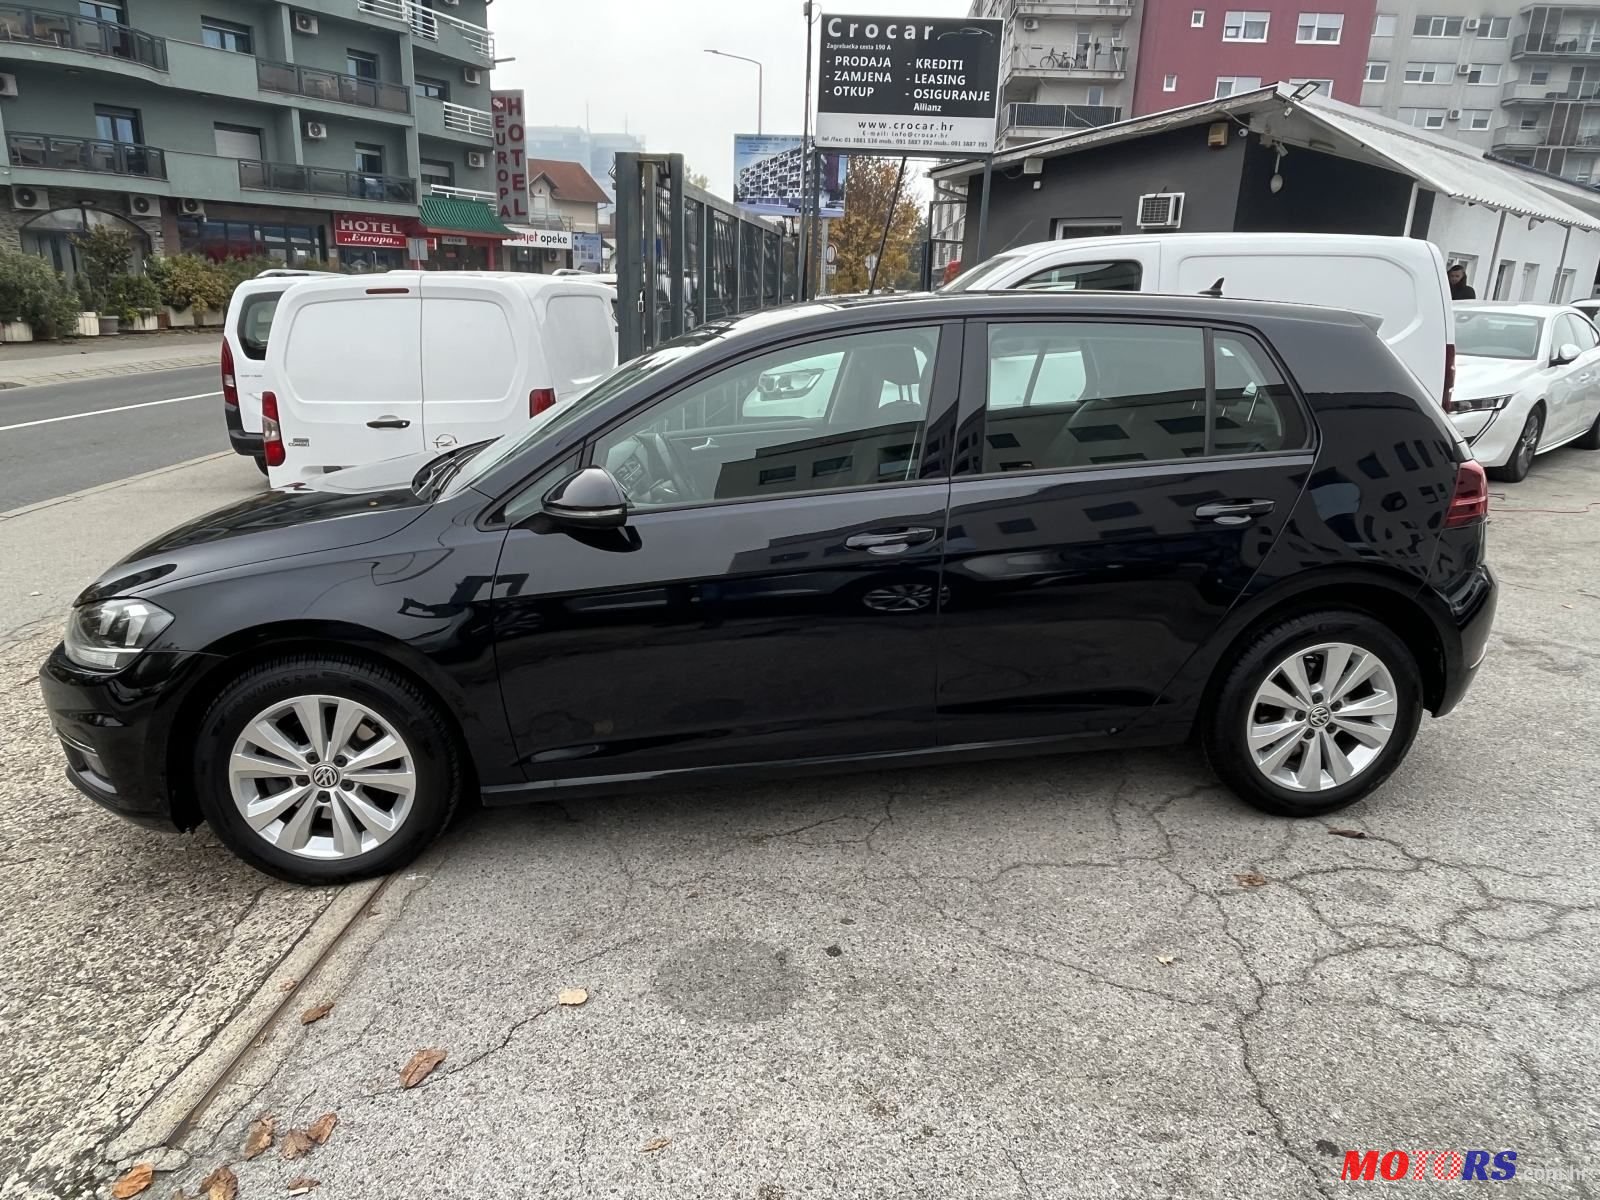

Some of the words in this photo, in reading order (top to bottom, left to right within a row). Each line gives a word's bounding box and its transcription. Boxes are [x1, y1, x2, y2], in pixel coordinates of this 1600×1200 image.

[827, 17, 934, 40] Crocar
[835, 55, 892, 68] PRODAJA
[915, 58, 964, 70] KREDITI
[833, 71, 892, 83] ZAMJENA
[914, 73, 966, 86] LEASING
[833, 86, 874, 97] OTKUP
[913, 89, 990, 101] OSIGURANJE
[913, 102, 942, 112] Allianz
[858, 121, 954, 131] www.crocar.hr
[507, 97, 527, 217] HOTEL
[495, 115, 511, 217] EUROPA
[340, 219, 402, 234] HOTEL
[540, 233, 568, 245] opeke
